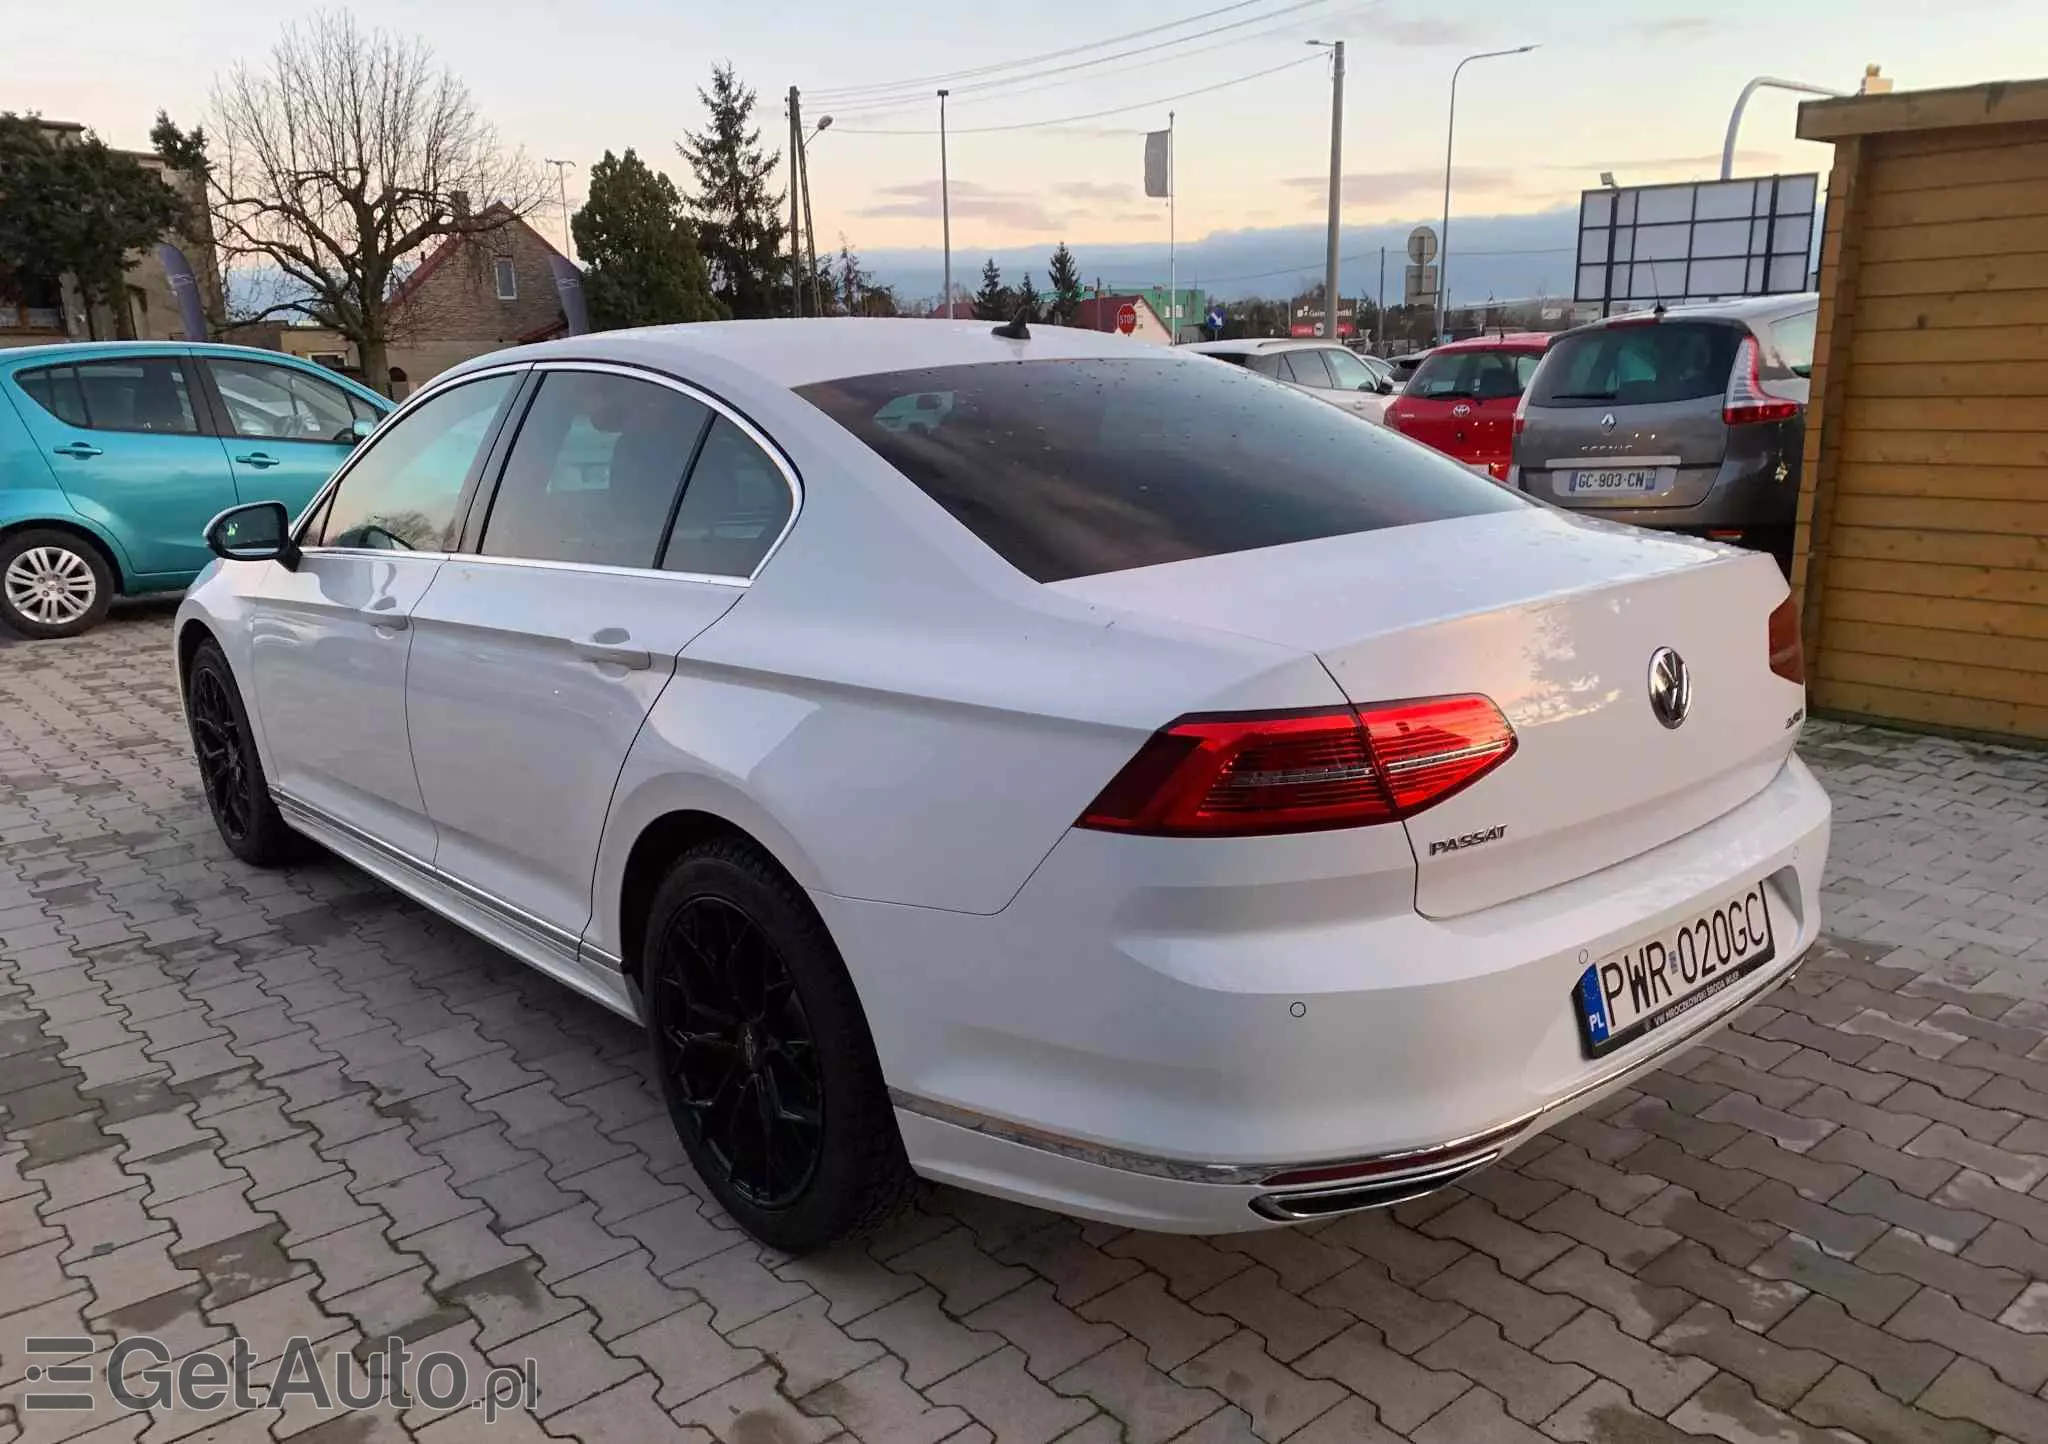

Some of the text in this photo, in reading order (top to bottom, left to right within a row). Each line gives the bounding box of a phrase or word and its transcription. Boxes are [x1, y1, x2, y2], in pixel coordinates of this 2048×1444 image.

[1120, 313, 1135, 324] STOP
[1429, 823, 1508, 857] PASSAT
[1600, 891, 1765, 1028] PWR 020GC
[1589, 1011, 1605, 1033] PL
